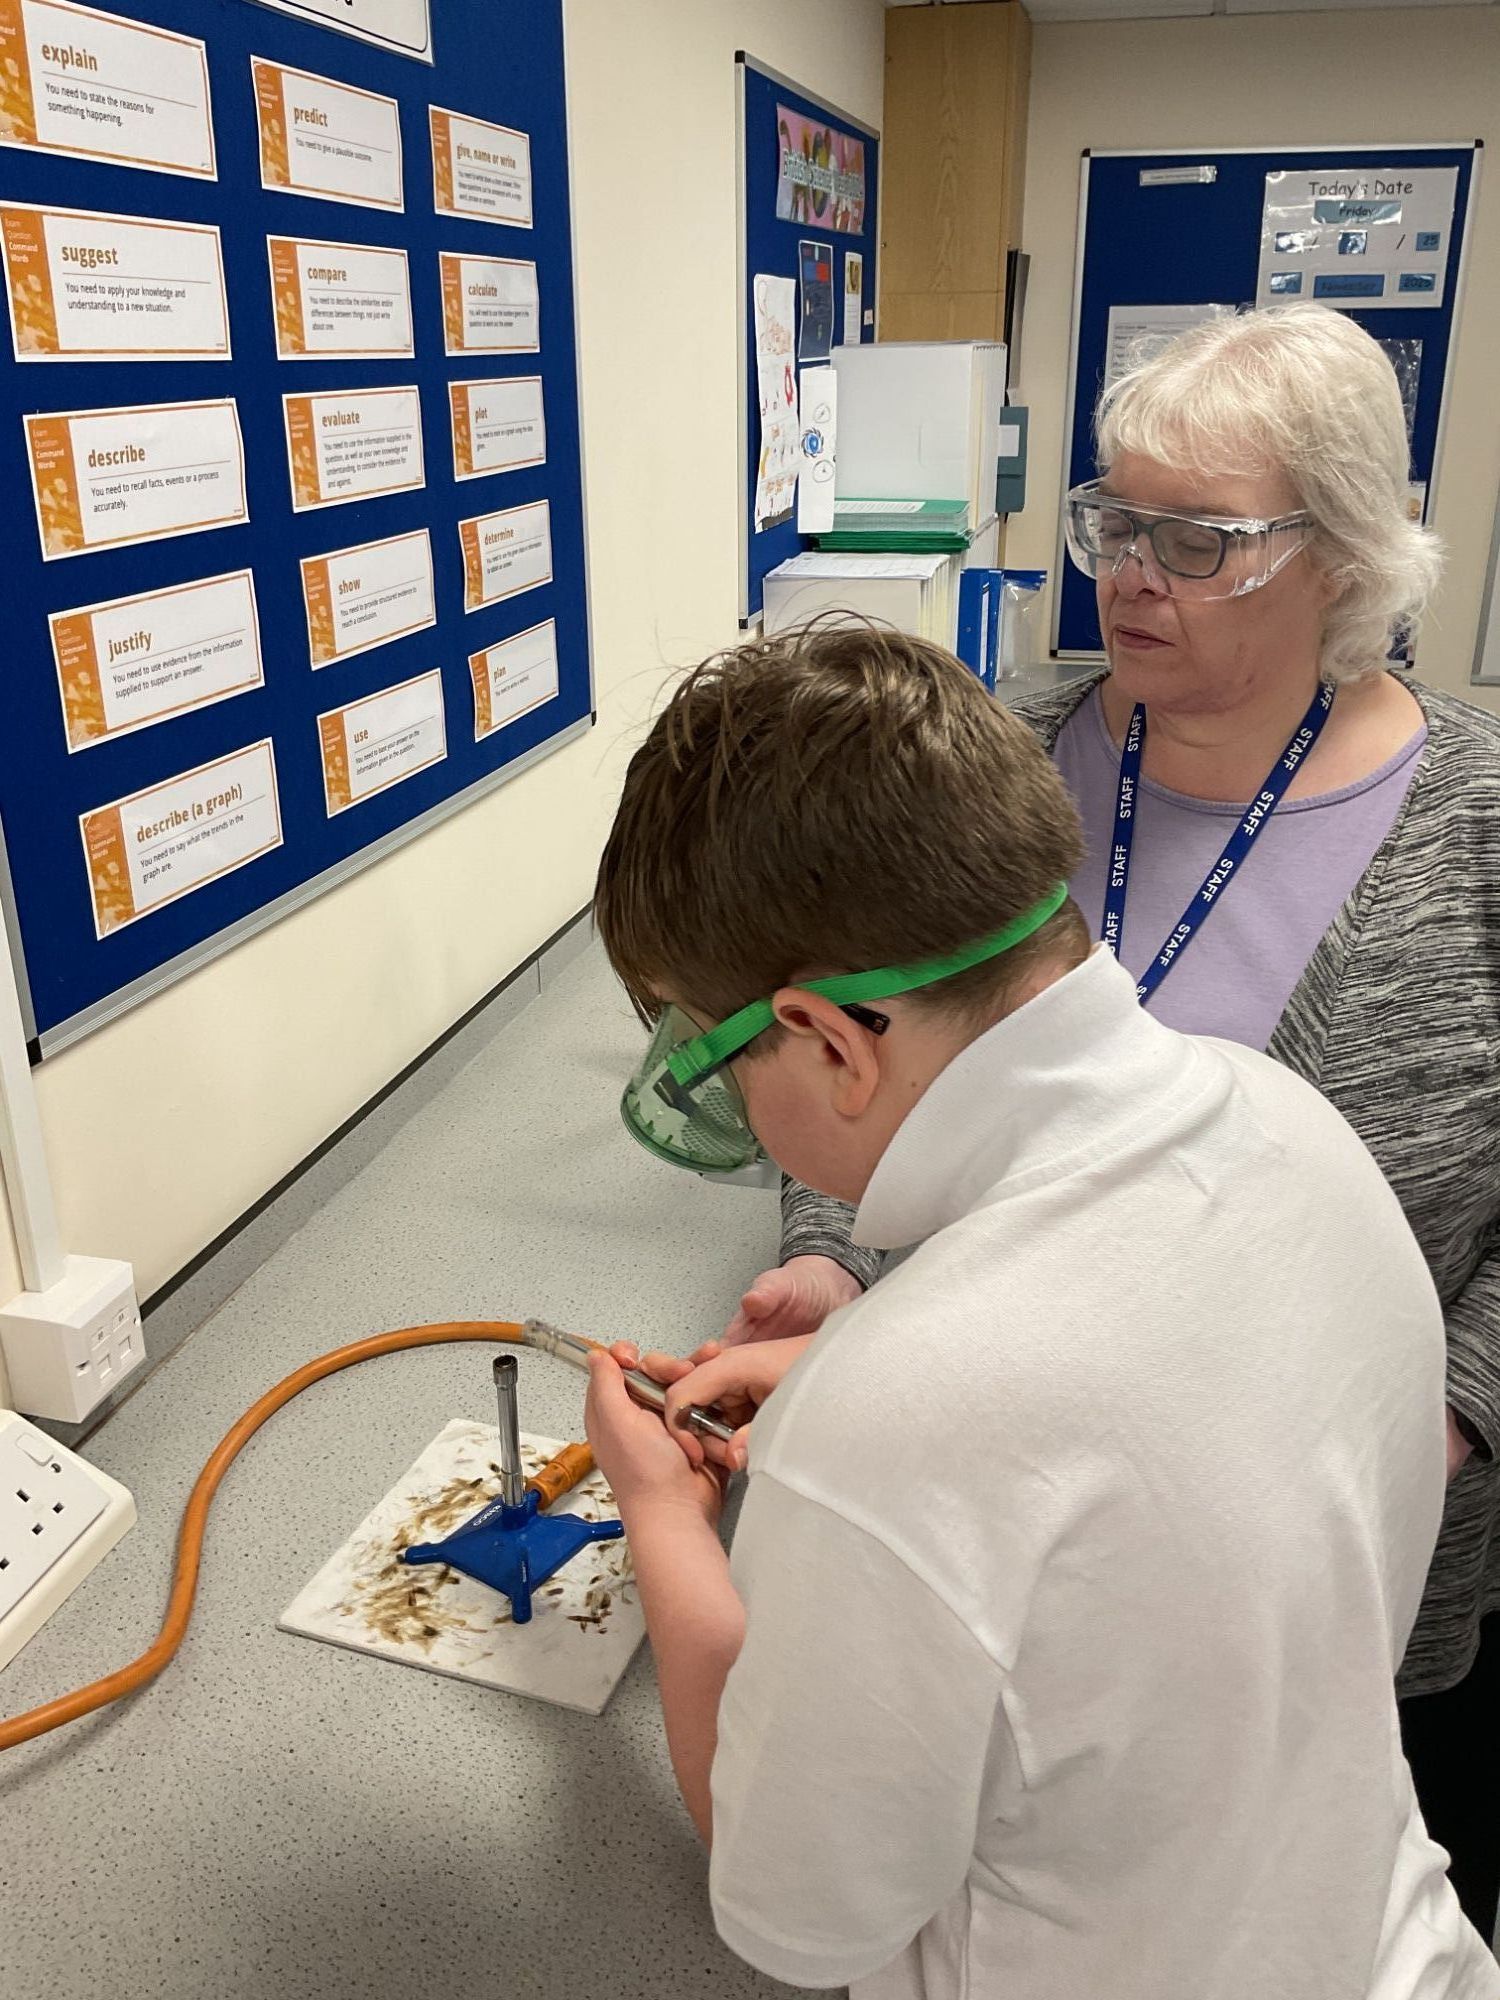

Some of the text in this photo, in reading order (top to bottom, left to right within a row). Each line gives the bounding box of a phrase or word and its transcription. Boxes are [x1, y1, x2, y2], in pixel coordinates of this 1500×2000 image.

[42, 44, 97, 71] explain
[46, 83, 154, 114] You need to state the reasons for
[48, 102, 85, 119] something
[294, 107, 328, 127] predict
[1308, 179, 1413, 199] Today's Date
[1339, 205, 1375, 217] Friday
[1423, 235, 1438, 246] 25
[62, 246, 118, 268] suggest
[308, 267, 347, 284] compare
[65, 283, 186, 299] You need to apply your knowledge and
[469, 283, 497, 297] calculate
[68, 300, 116, 313] understanding
[117, 302, 125, 311] to
[322, 410, 360, 427] evaluate
[475, 407, 487, 423] plot
[88, 445, 145, 468] describe
[91, 487, 104, 497] You
[106, 484, 121, 495] need
[123, 484, 130, 493] to
[131, 479, 147, 490] recall
[148, 477, 164, 489] facts,
[165, 477, 184, 486] events
[186, 476, 192, 484] or
[198, 472, 219, 484] process
[93, 499, 129, 513] accurately.
[485, 528, 514, 545] determine
[339, 578, 360, 595] show
[108, 630, 152, 662] justify
[113, 638, 243, 684] You need to use evidence from the information
[494, 666, 506, 683] plan
[115, 682, 142, 699] supplied
[143, 681, 149, 690] to
[151, 674, 173, 688] support
[354, 729, 368, 743] use
[1127, 713, 1142, 752] STAFF
[1284, 727, 1313, 771] STAFF
[1120, 776, 1134, 819] STAFF
[137, 809, 189, 843] describe
[192, 802, 204, 820] (a
[206, 783, 243, 815] graph)
[1243, 791, 1274, 836] STAFF
[140, 814, 244, 868] You need to say what the trends in the
[142, 868, 160, 884] graph
[1112, 845, 1127, 887] STAFF
[1202, 858, 1234, 902] STAFF
[1160, 923, 1191, 967] STAFF
